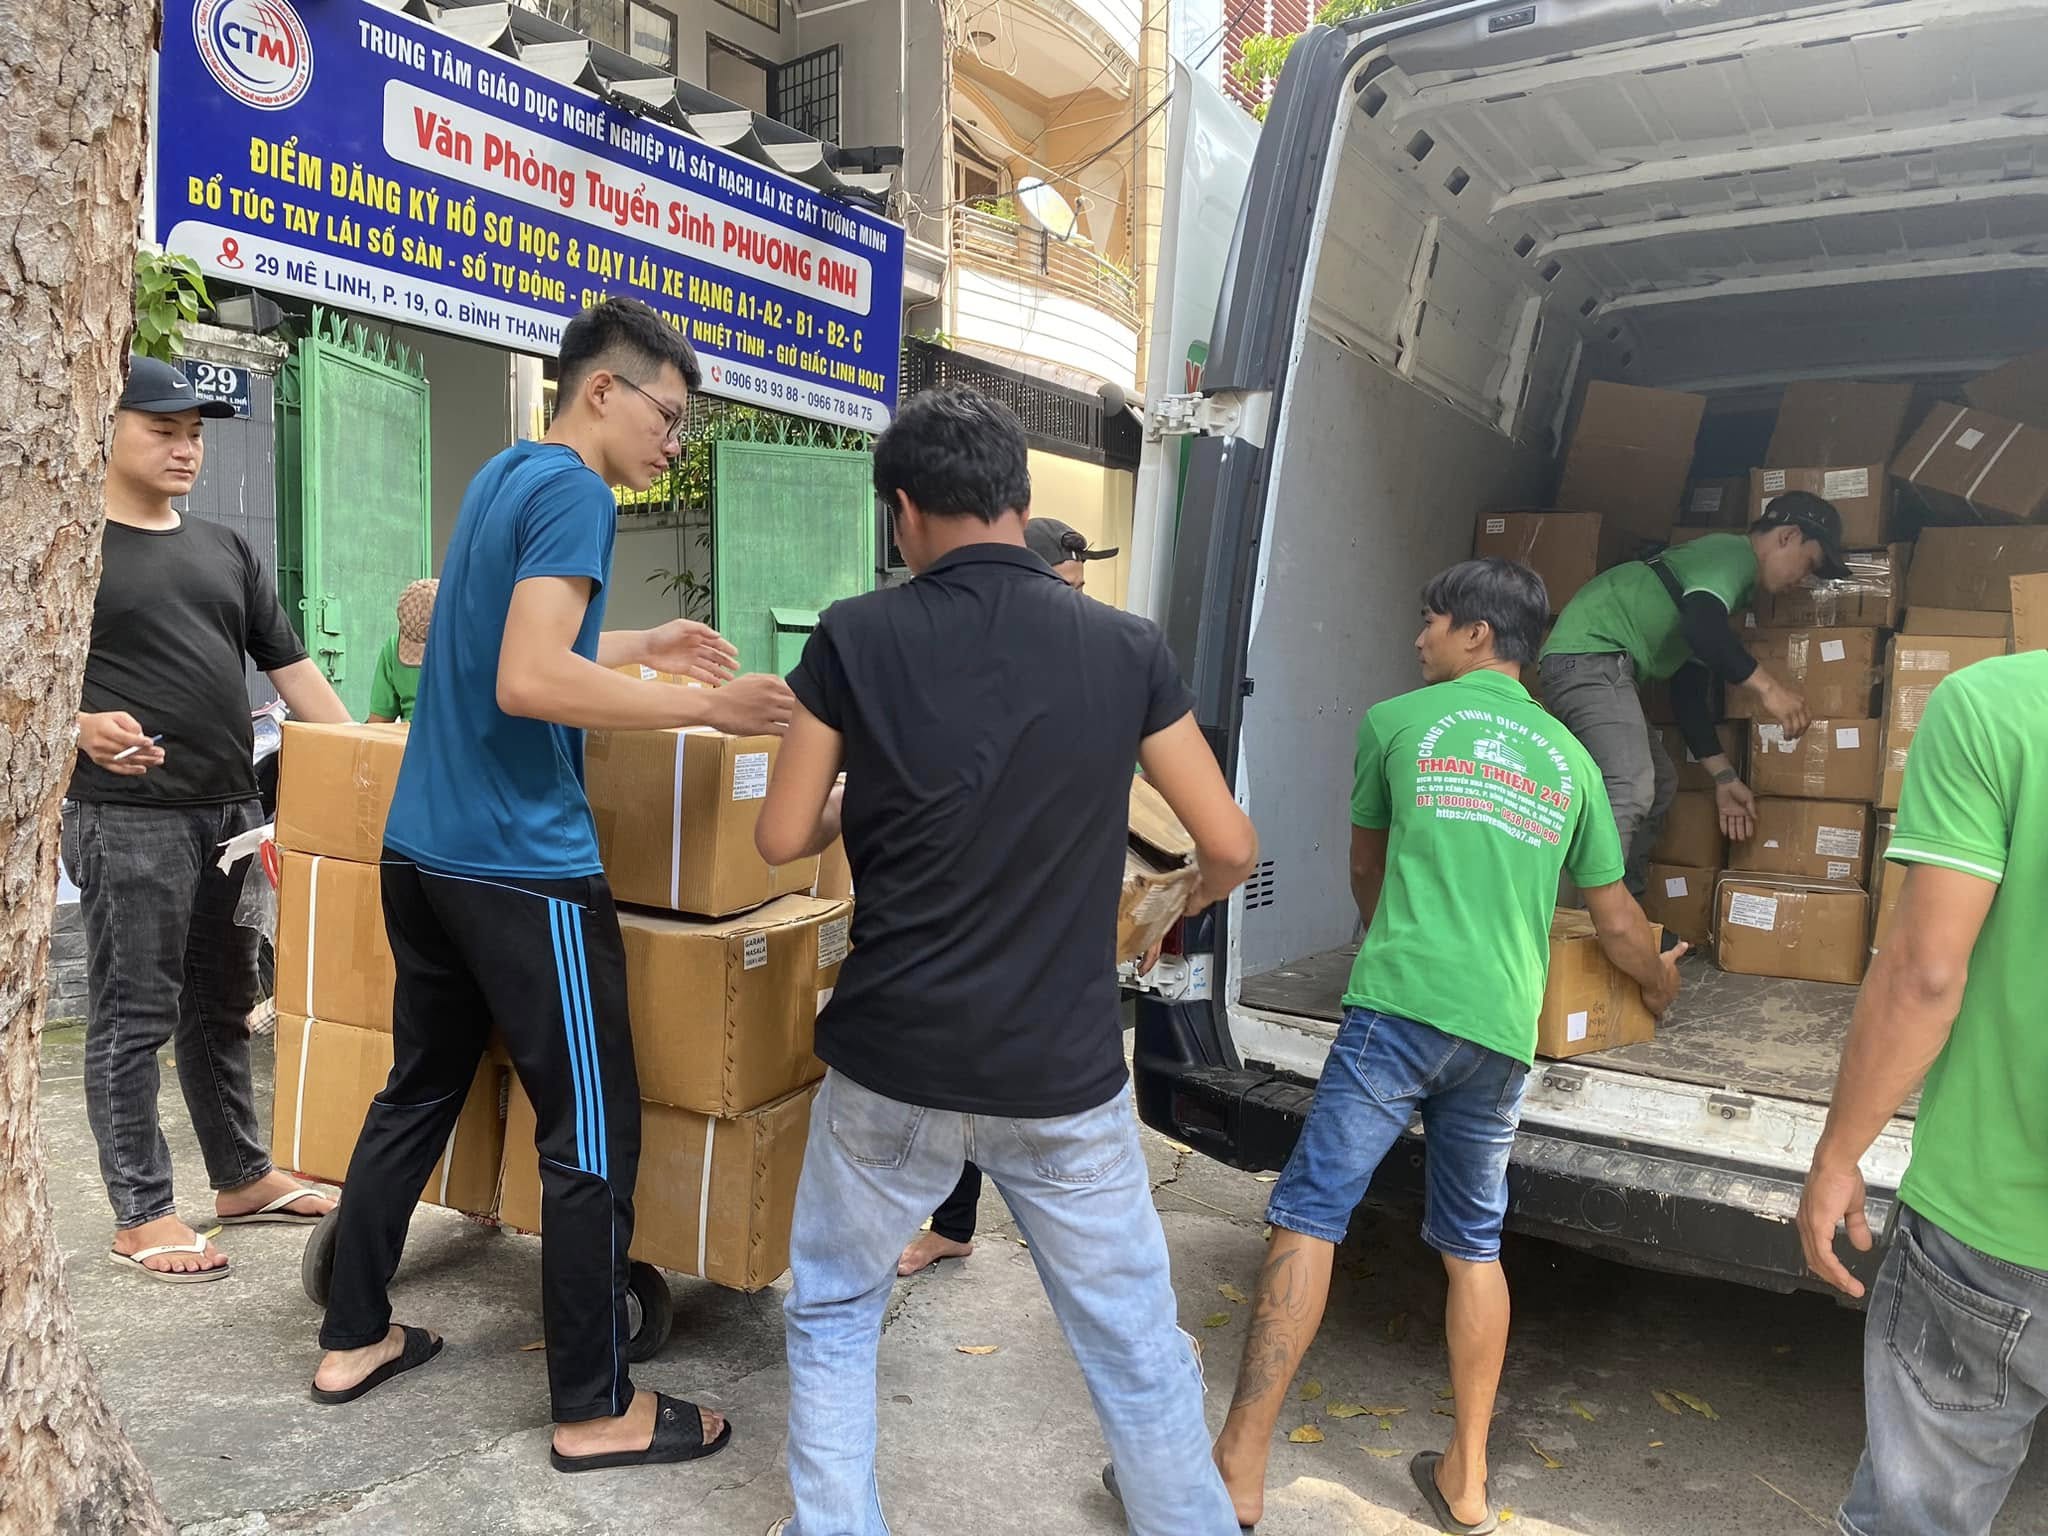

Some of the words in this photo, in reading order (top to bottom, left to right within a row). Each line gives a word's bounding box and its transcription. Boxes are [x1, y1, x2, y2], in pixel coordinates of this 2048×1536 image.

[222, 22, 286, 66] CTM
[358, 20, 425, 71] TRUNG
[431, 49, 472, 90] TÂM
[478, 69, 519, 107] GIÁO
[525, 87, 558, 123] DỤC
[563, 103, 606, 141] NGHỀ
[610, 124, 664, 165] NGHIỆP
[668, 145, 686, 173] VÀ
[689, 153, 715, 184] SÁT
[718, 167, 753, 197] HẠCH
[756, 180, 775, 207] LÁI
[778, 189, 793, 212] XE
[796, 196, 819, 225] CÁT
[821, 206, 857, 240] TƯỜNG
[859, 223, 887, 253] MINH
[414, 106, 472, 165] Văn
[484, 132, 575, 208] Phòng
[585, 169, 659, 229] Tuyển
[667, 200, 716, 249] Sinh
[722, 220, 812, 281] PHƯƠNG
[818, 256, 857, 298] ANH
[250, 135, 322, 191] ĐIỂM
[330, 161, 401, 215] ĐĂNG
[409, 187, 439, 225] KÝ
[446, 195, 477, 237] HỒ
[484, 211, 513, 248] SƠ
[519, 221, 560, 264] HỌC
[566, 238, 581, 268] &
[587, 243, 624, 283] DẠY
[629, 254, 657, 291] LÁI
[662, 266, 684, 299] XE
[689, 277, 733, 314] HẠNG
[737, 292, 783, 329] A1-A2
[796, 310, 813, 338] B1
[854, 329, 862, 354] C
[188, 173, 223, 210] BỔ
[229, 187, 275, 225] TÚC
[282, 202, 320, 237] TAY
[327, 215, 361, 248] LÁI
[368, 225, 396, 257] SỐ
[401, 236, 443, 270] SÀN
[462, 252, 487, 282] SỐ
[492, 262, 515, 294] TỰ
[518, 269, 565, 303] ĐỘNG
[693, 320, 732, 350] NHIỆT
[736, 329, 765, 358] TÌNH
[776, 344, 797, 367] GIỜ
[830, 359, 855, 384] LINH
[858, 369, 886, 395] HOẠT
[254, 253, 279, 277] 29
[286, 260, 317, 286] MÊ
[324, 270, 377, 304] LINH,
[383, 284, 398, 305] P.
[404, 291, 429, 316] 19,
[434, 298, 452, 319] Q.
[459, 302, 500, 331] BÌNH
[505, 315, 561, 345] THẠNH
[197, 364, 238, 394] 29
[725, 370, 751, 390] 0906
[755, 377, 768, 395] 93
[770, 382, 783, 399] 93
[786, 386, 799, 402] 88
[808, 392, 831, 411] 0966
[834, 398, 845, 414] 78
[847, 402, 858, 418] 84
[861, 405, 873, 422] 75
[1417, 726, 1445, 757] CÔNG
[1437, 714, 1456, 728] TY
[1455, 710, 1493, 722] TNHH
[1417, 756, 1476, 776] THÂN
[1480, 763, 1538, 796] THIỆN
[1540, 785, 1571, 812] 247
